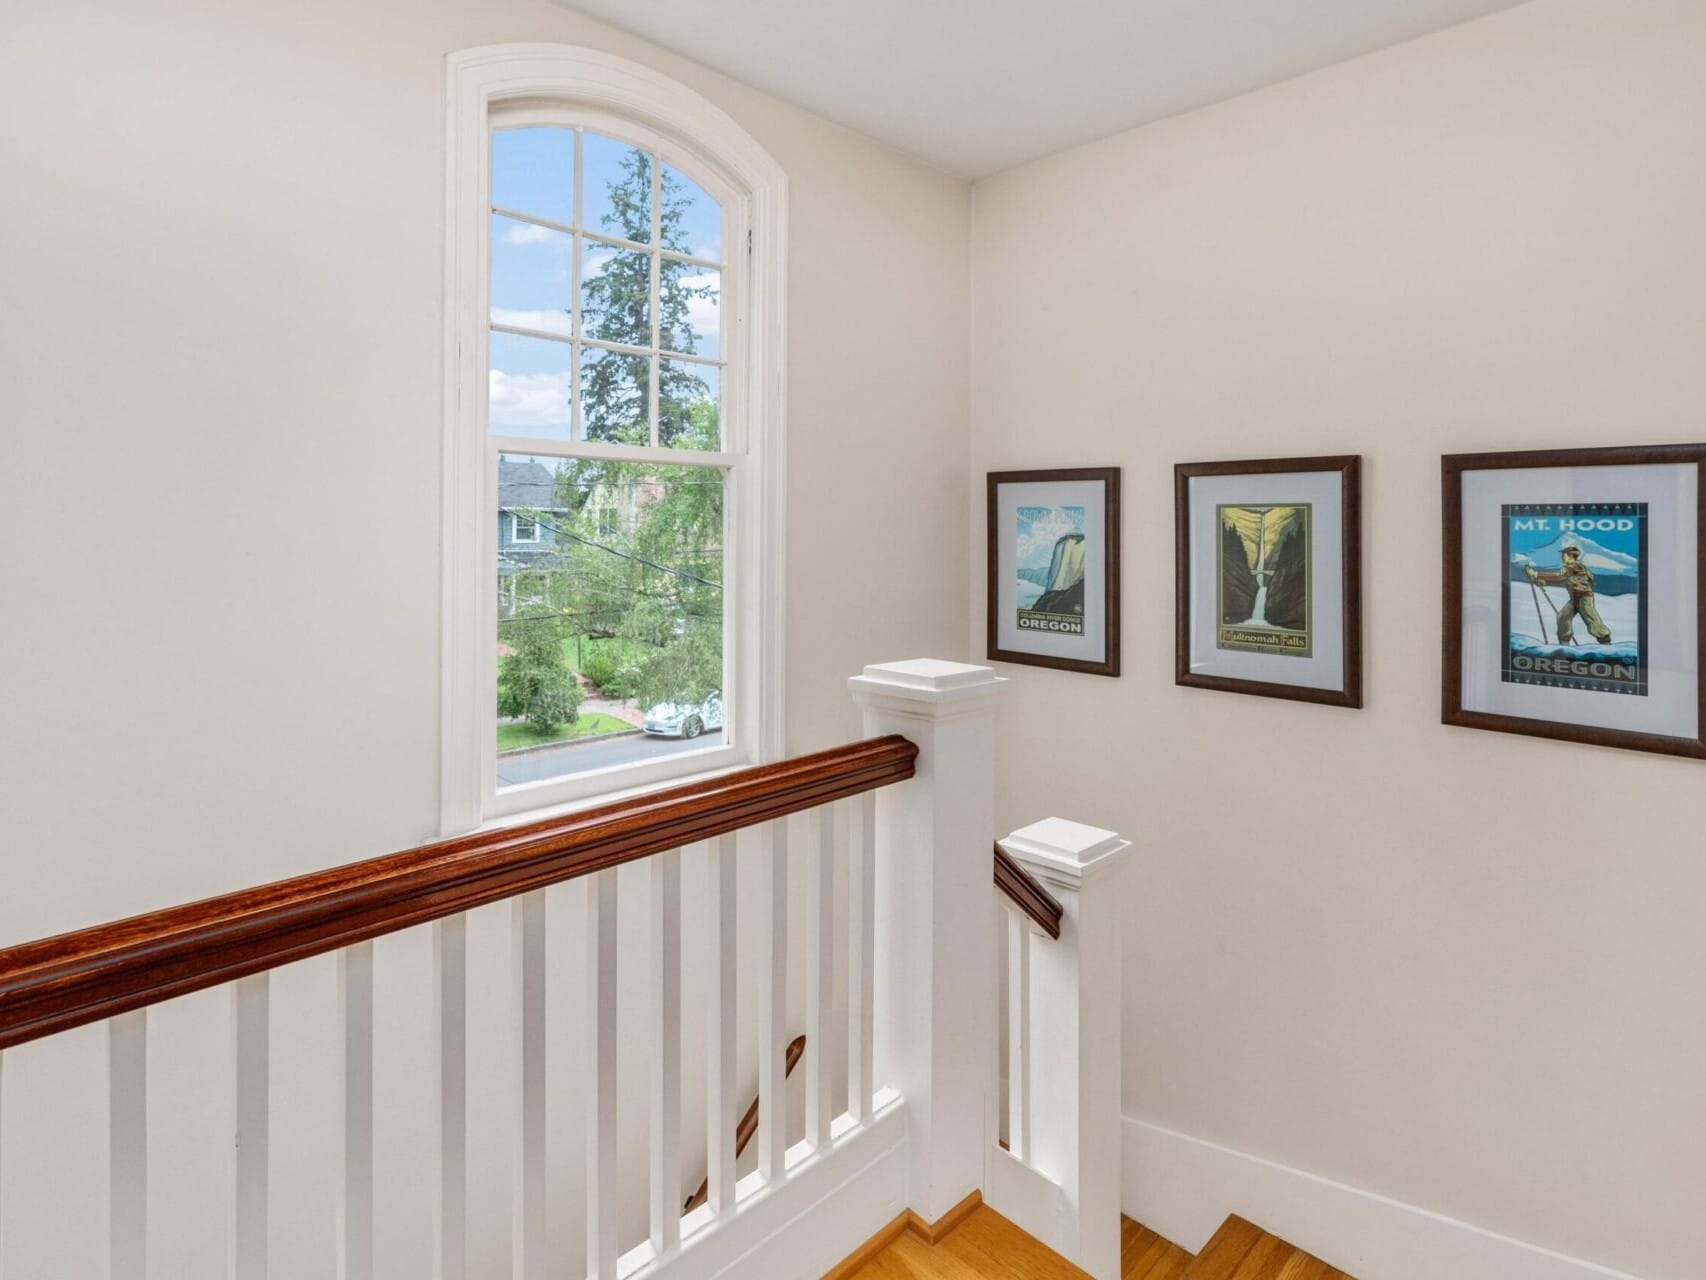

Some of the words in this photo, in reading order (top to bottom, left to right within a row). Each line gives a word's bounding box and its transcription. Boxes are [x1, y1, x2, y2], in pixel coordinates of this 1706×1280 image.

[1514, 519, 1550, 531] MT.
[1559, 519, 1634, 531] HOOD
[1019, 618, 1081, 633] OREGON
[1224, 630, 1279, 644] Multnomah
[1280, 635, 1305, 647] Falls
[1512, 655, 1636, 680] OREGON
